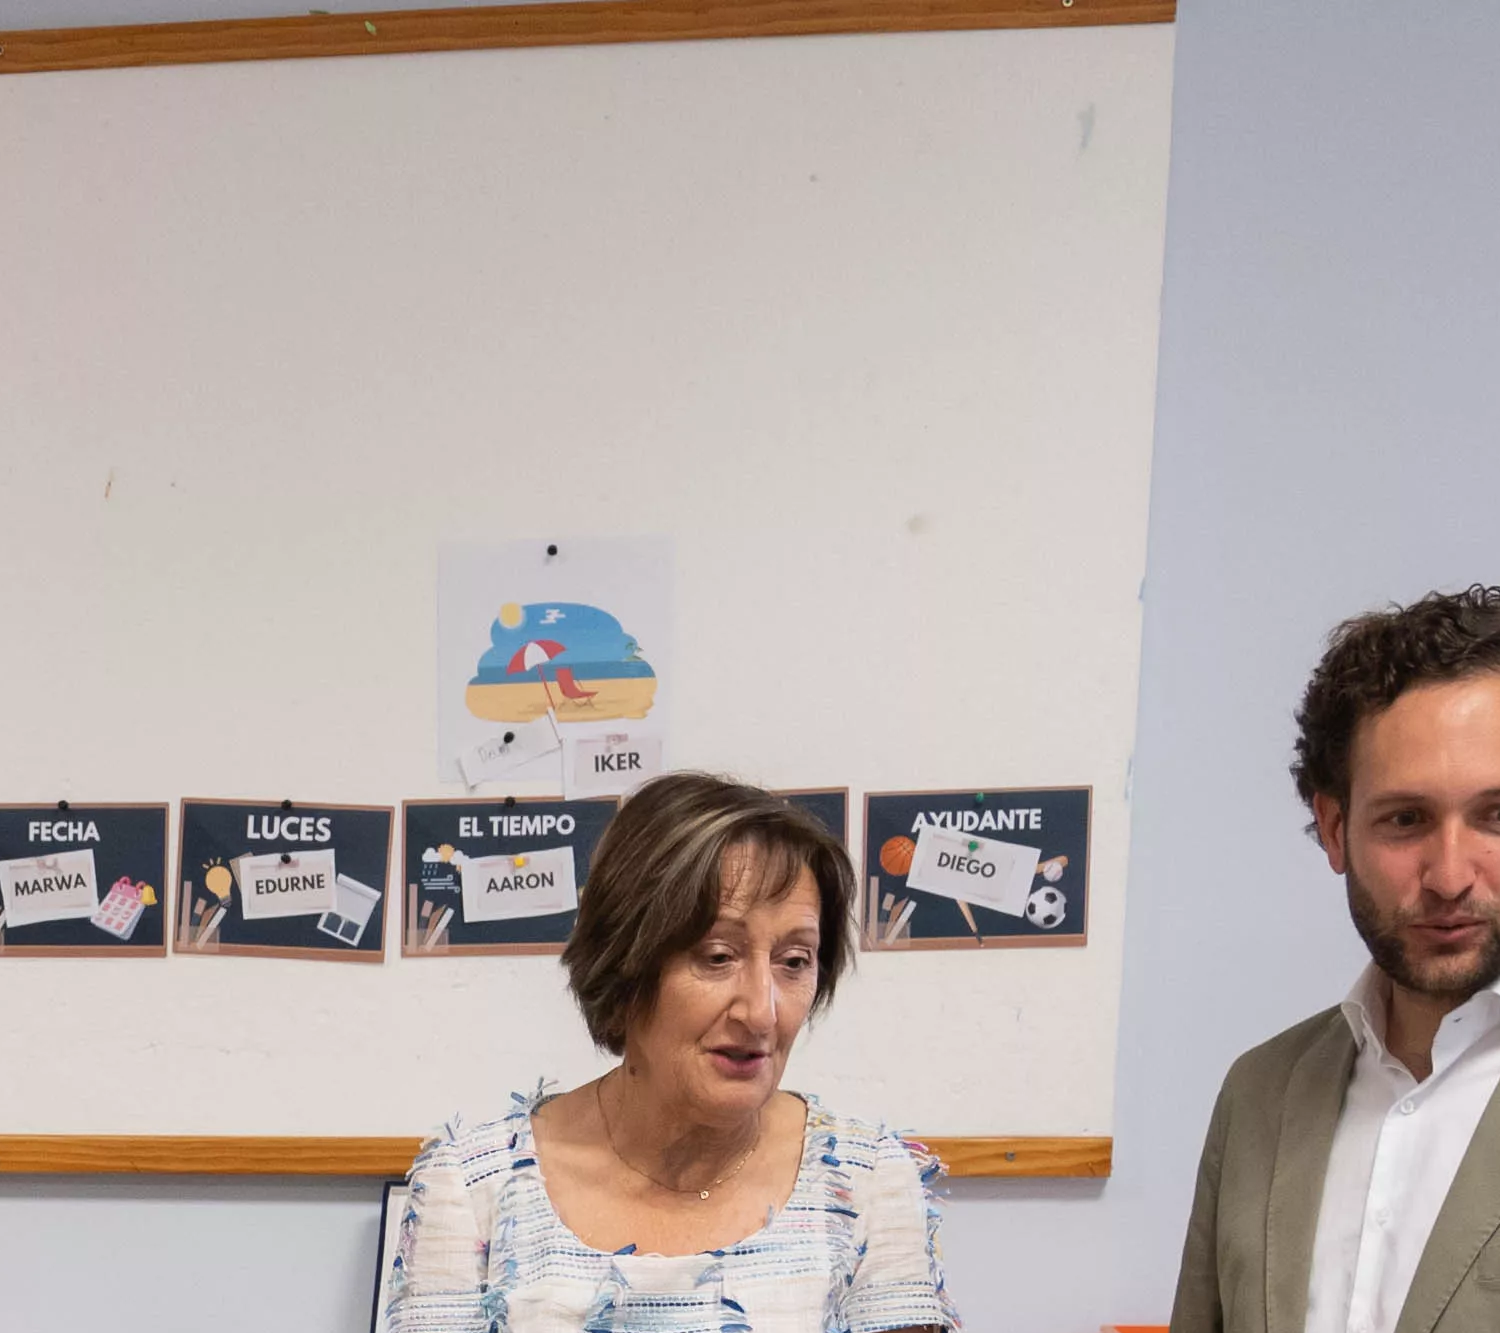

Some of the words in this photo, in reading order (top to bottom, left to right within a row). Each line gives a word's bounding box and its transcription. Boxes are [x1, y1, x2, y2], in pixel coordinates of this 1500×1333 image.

[594, 752, 642, 773] IKER
[28, 819, 101, 842] FECHA
[246, 814, 332, 843] LUCES
[458, 816, 484, 838] EL
[489, 814, 576, 837] TIEMPO
[911, 808, 1042, 833] AYUDANTE
[936, 851, 996, 878] DIEGO
[13, 872, 87, 897] MARWA
[254, 872, 326, 896] EDURNE
[486, 872, 555, 894] AARON
